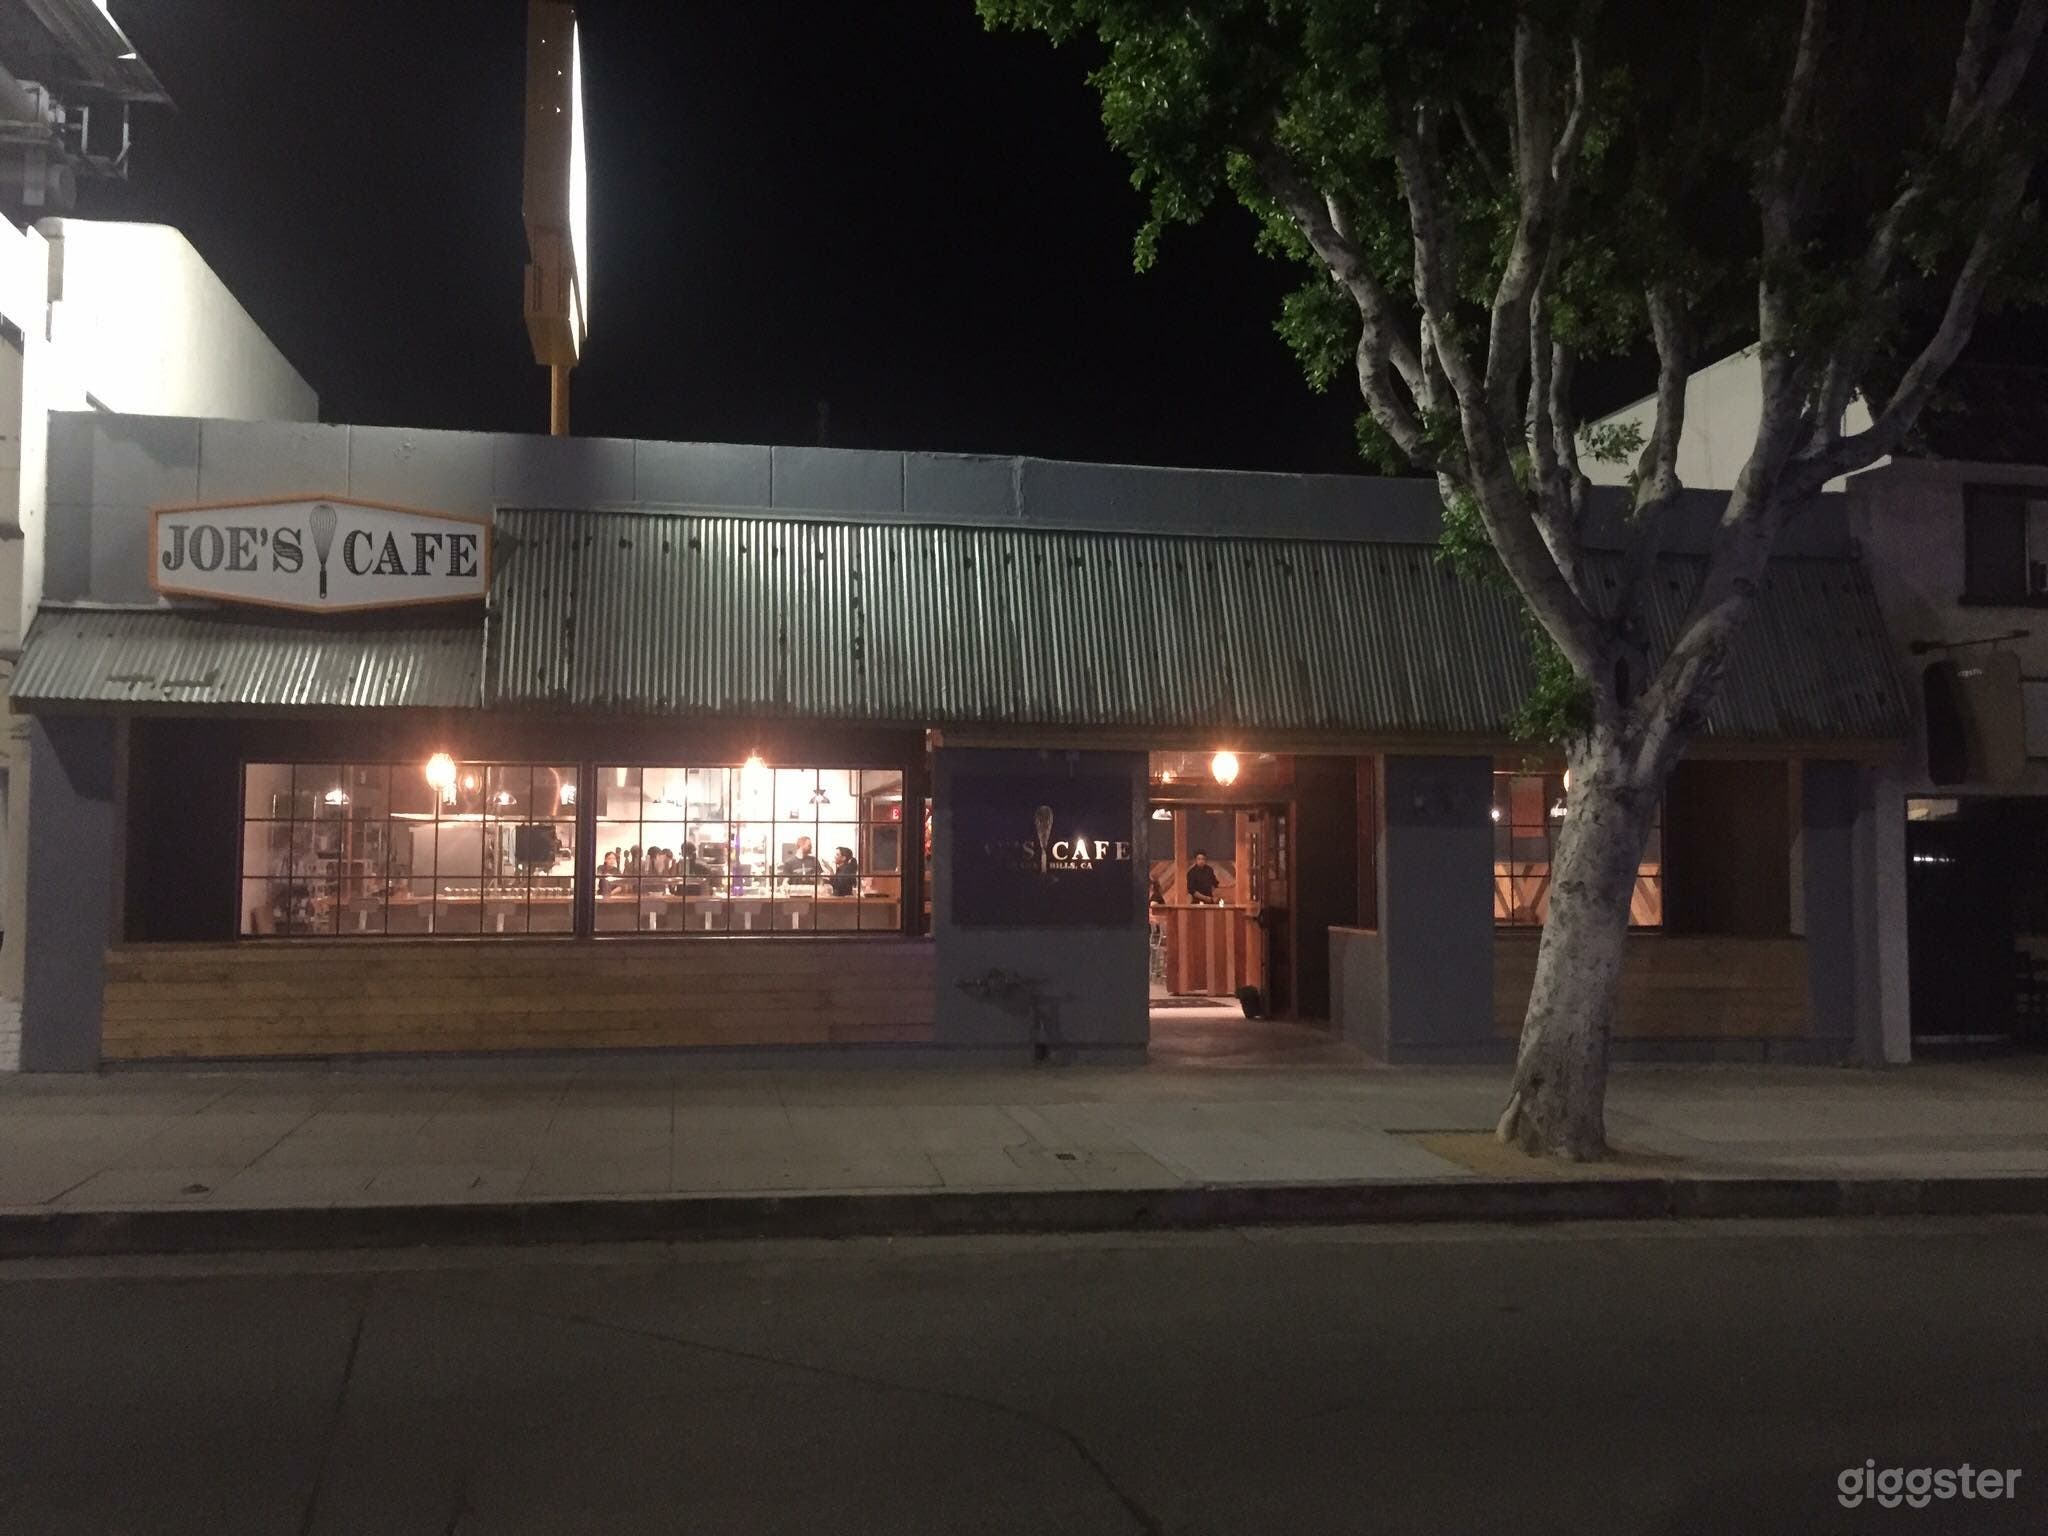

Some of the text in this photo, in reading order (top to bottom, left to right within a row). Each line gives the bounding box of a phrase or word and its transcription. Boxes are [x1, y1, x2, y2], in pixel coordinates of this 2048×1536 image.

[162, 524, 477, 577] JOE'S CAFE
[1052, 839, 1131, 860] CAFE
[1081, 862, 1093, 870] CA
